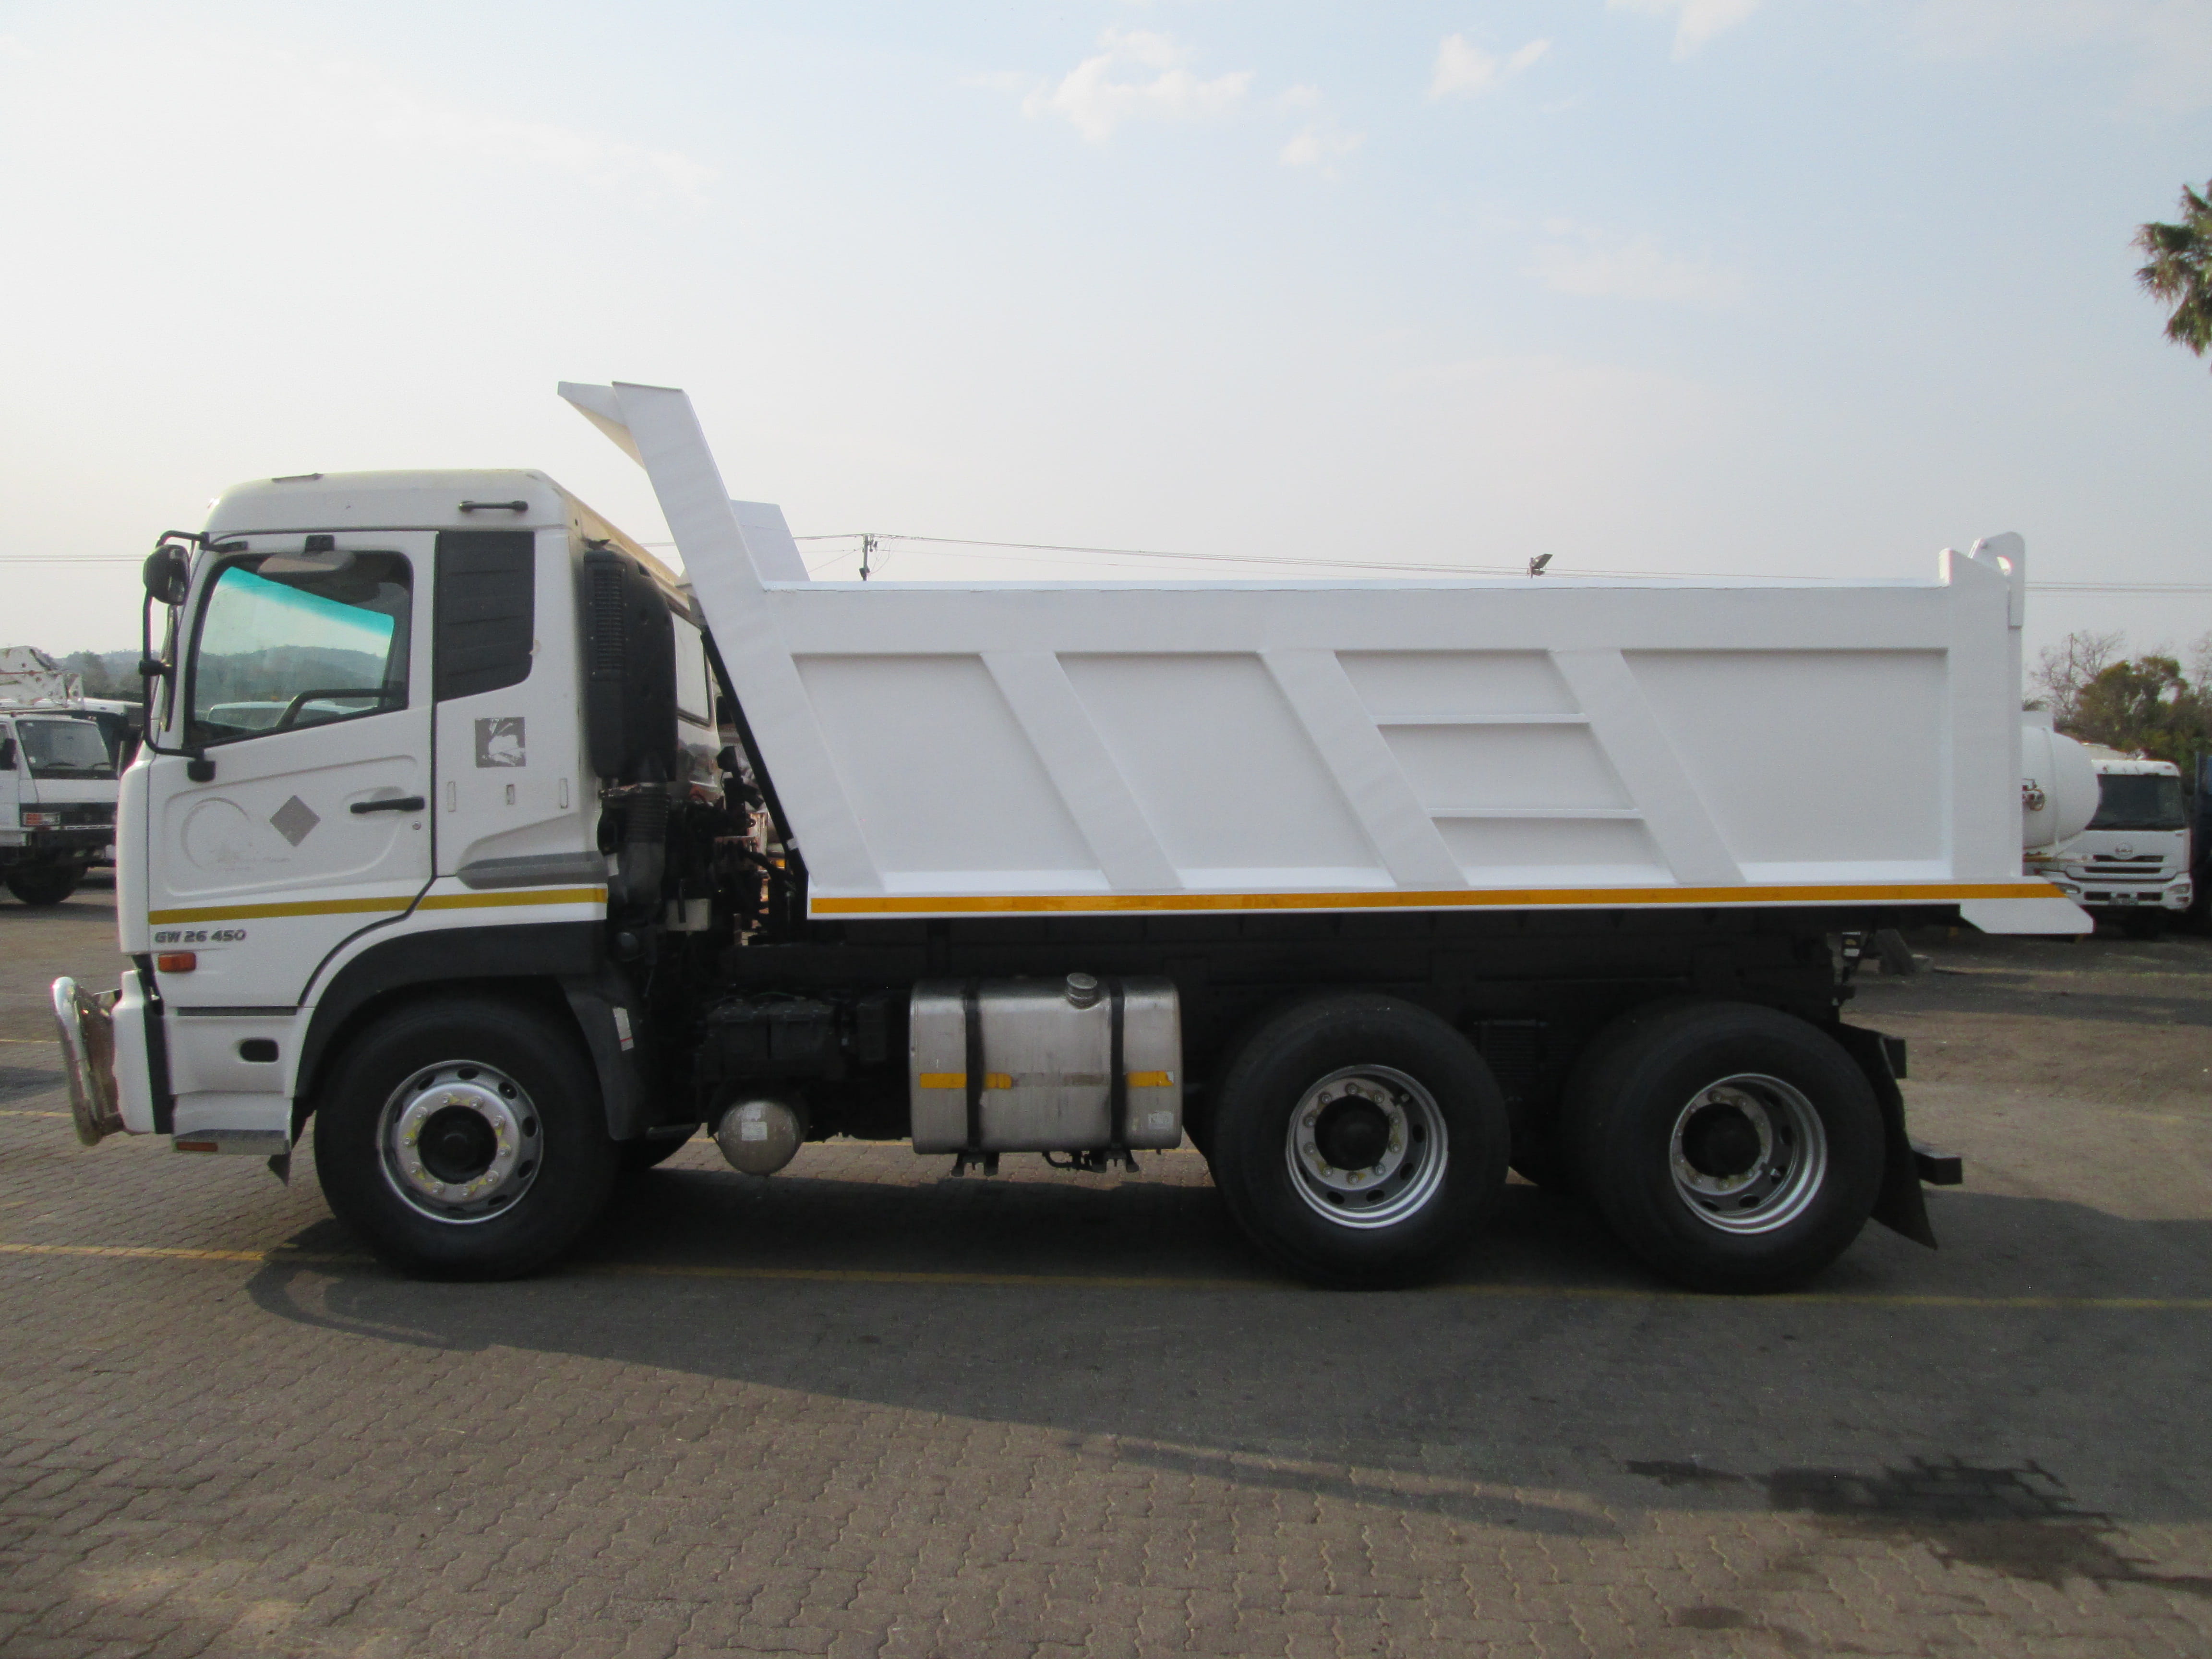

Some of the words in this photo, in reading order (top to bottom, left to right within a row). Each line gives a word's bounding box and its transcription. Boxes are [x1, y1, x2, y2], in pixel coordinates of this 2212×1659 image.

[155, 931, 181, 943] GW
[184, 930, 208, 942] 26
[210, 929, 247, 941] 450
